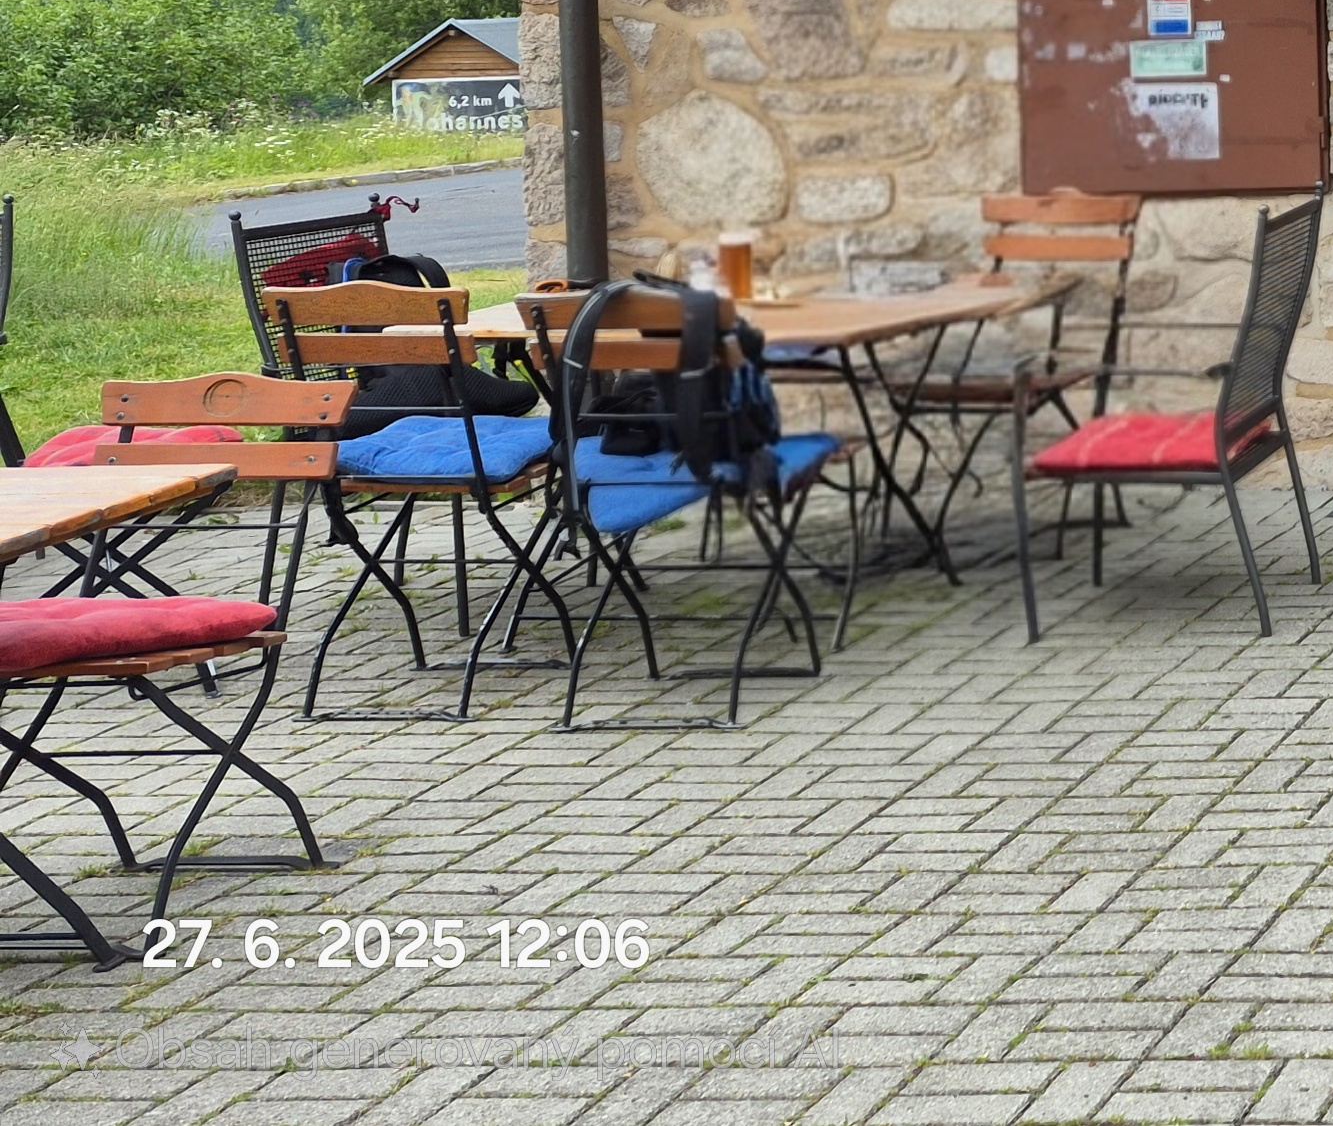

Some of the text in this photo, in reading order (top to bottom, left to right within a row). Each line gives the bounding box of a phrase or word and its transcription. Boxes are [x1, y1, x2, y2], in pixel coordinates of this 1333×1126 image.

[448, 94, 493, 109] 6,2 km
[426, 113, 524, 131] ohannes
